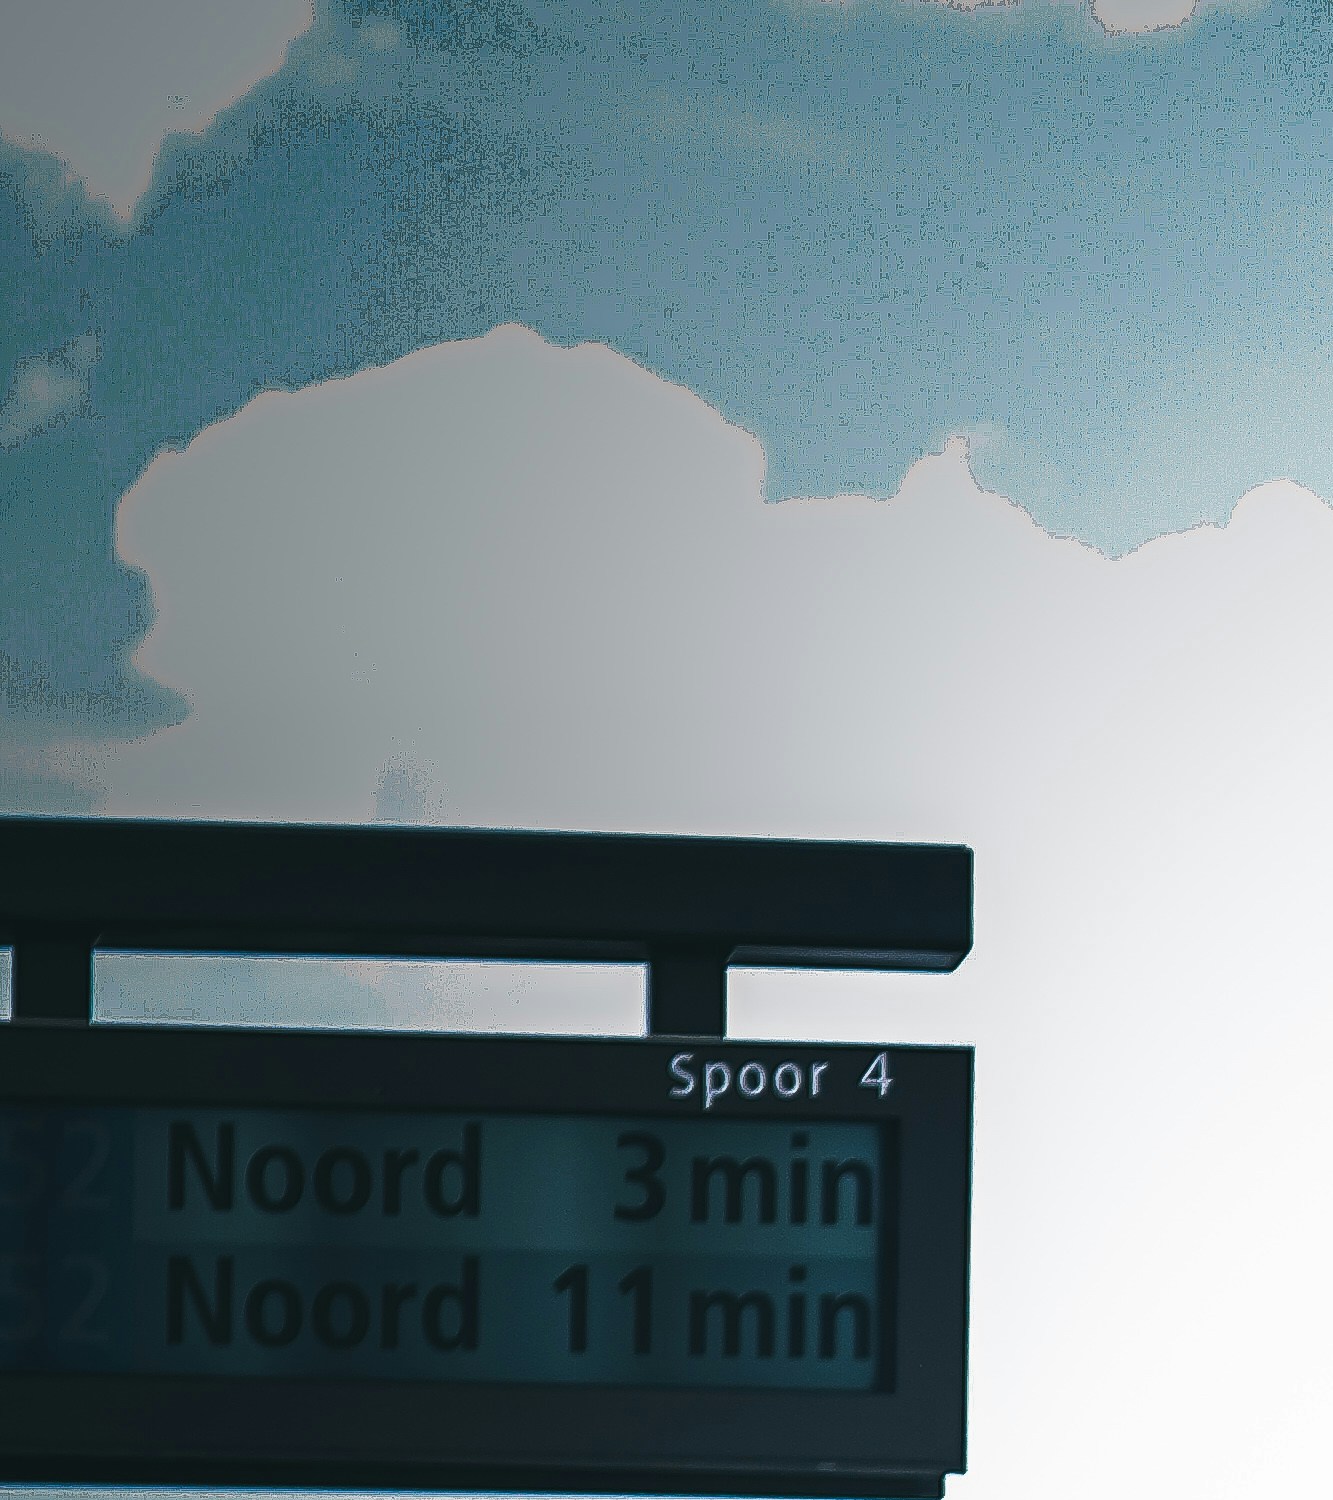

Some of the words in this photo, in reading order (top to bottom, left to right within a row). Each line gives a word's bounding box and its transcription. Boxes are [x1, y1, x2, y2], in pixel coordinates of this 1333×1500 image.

[669, 1052, 829, 1110] Spoor
[859, 1052, 894, 1098] 4
[167, 1122, 482, 1217] Noord
[613, 1131, 667, 1222] 3
[690, 1133, 873, 1226] min
[166, 1256, 480, 1350] Noord
[553, 1265, 653, 1355] 11
[689, 1266, 871, 1360] min
